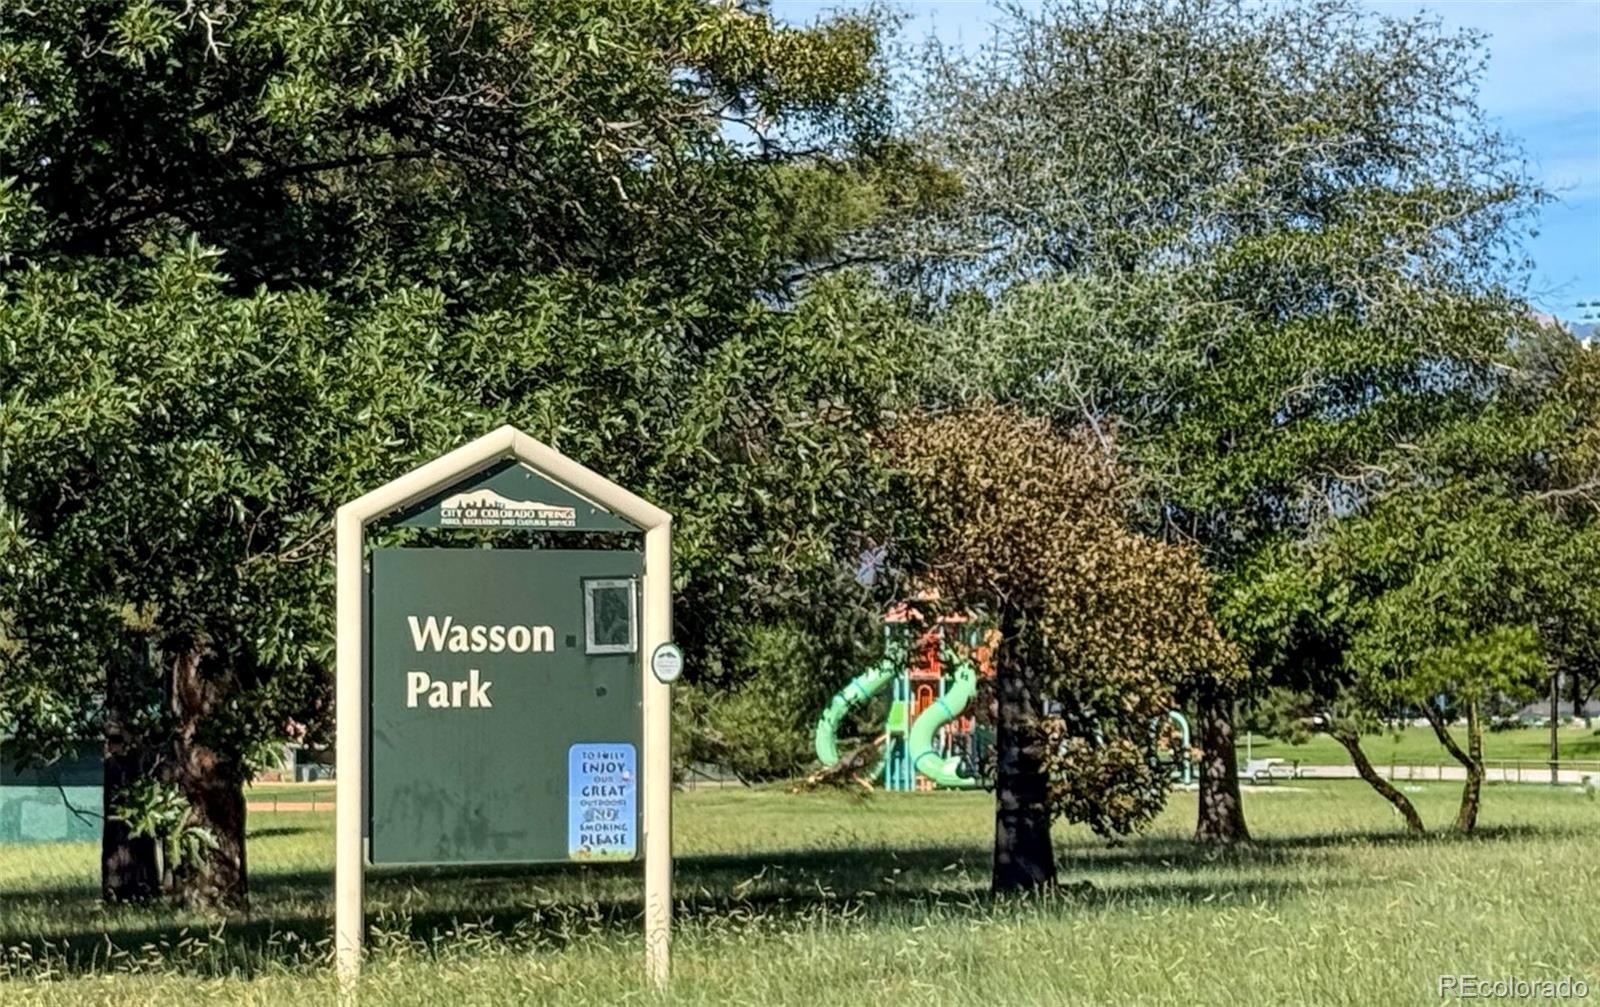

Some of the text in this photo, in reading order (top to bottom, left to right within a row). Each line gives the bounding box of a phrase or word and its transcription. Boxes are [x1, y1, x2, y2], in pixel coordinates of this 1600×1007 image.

[441, 509, 576, 520] CITY OF COLORADO SPRINGS
[407, 615, 555, 653] Wasson
[407, 669, 493, 708] Park
[582, 751, 595, 760] TO
[582, 762, 626, 774] ENJOY
[594, 776, 613, 784] OUR
[582, 785, 626, 797] GREAT
[580, 823, 628, 832] SMOKING
[580, 834, 627, 844] PLEASE
